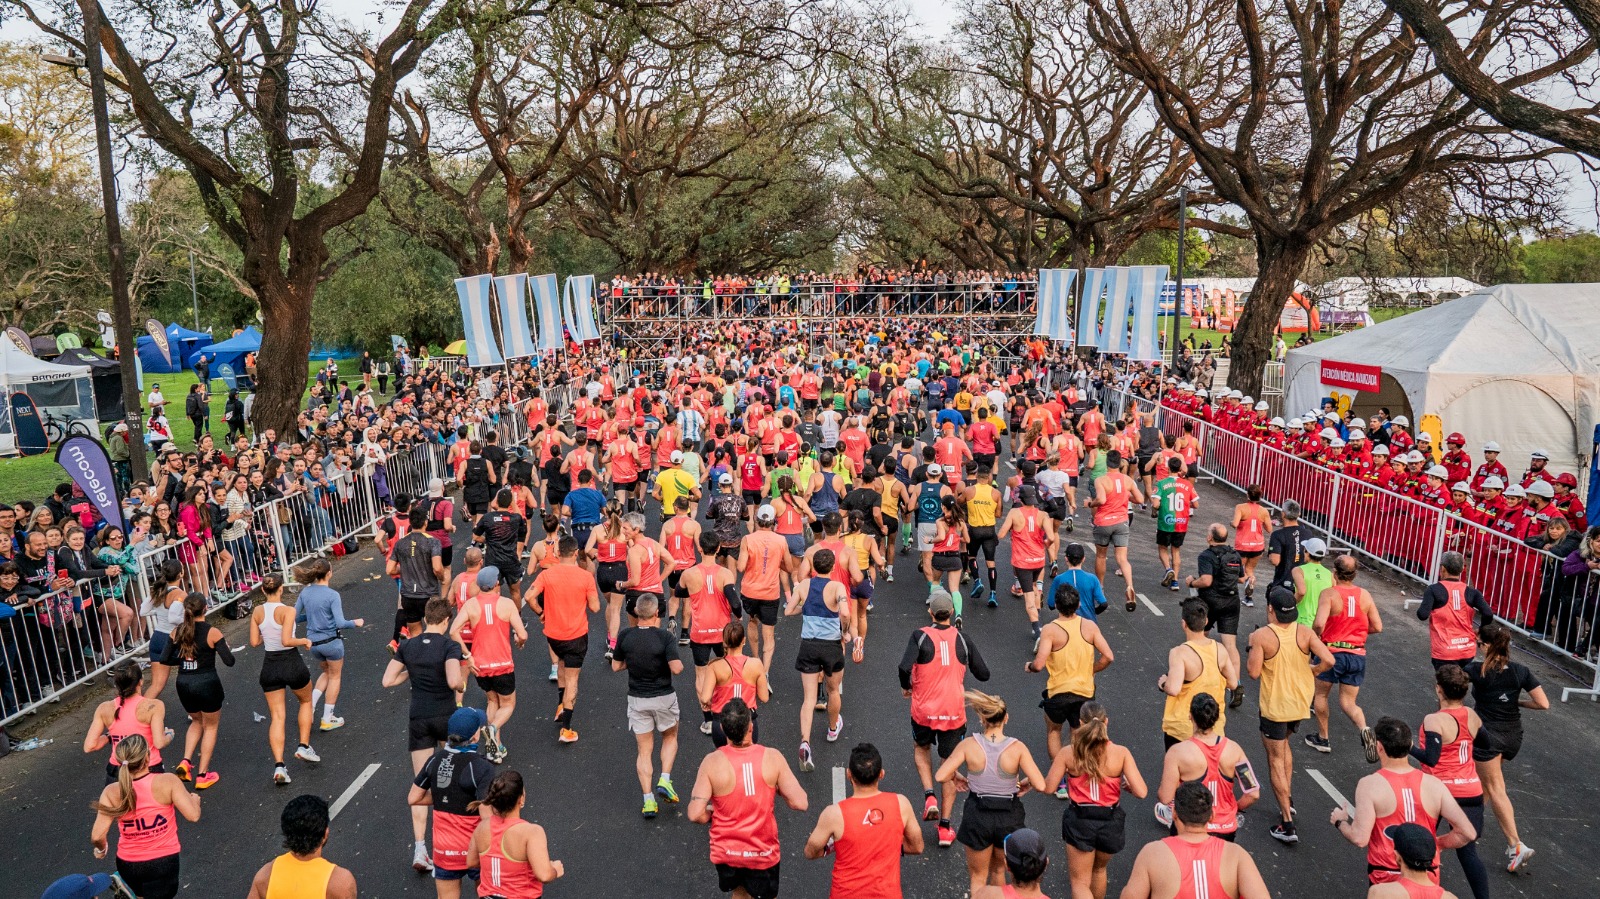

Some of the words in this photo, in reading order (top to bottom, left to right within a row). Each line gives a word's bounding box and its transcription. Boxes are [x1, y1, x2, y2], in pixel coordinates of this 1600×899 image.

[1322, 367, 1339, 380] ATENCIÓN
[1340, 369, 1355, 382] MÉDICA
[1355, 372, 1377, 386] AVANZADA
[1166, 492, 1184, 512] 16
[122, 814, 168, 832] FILA
